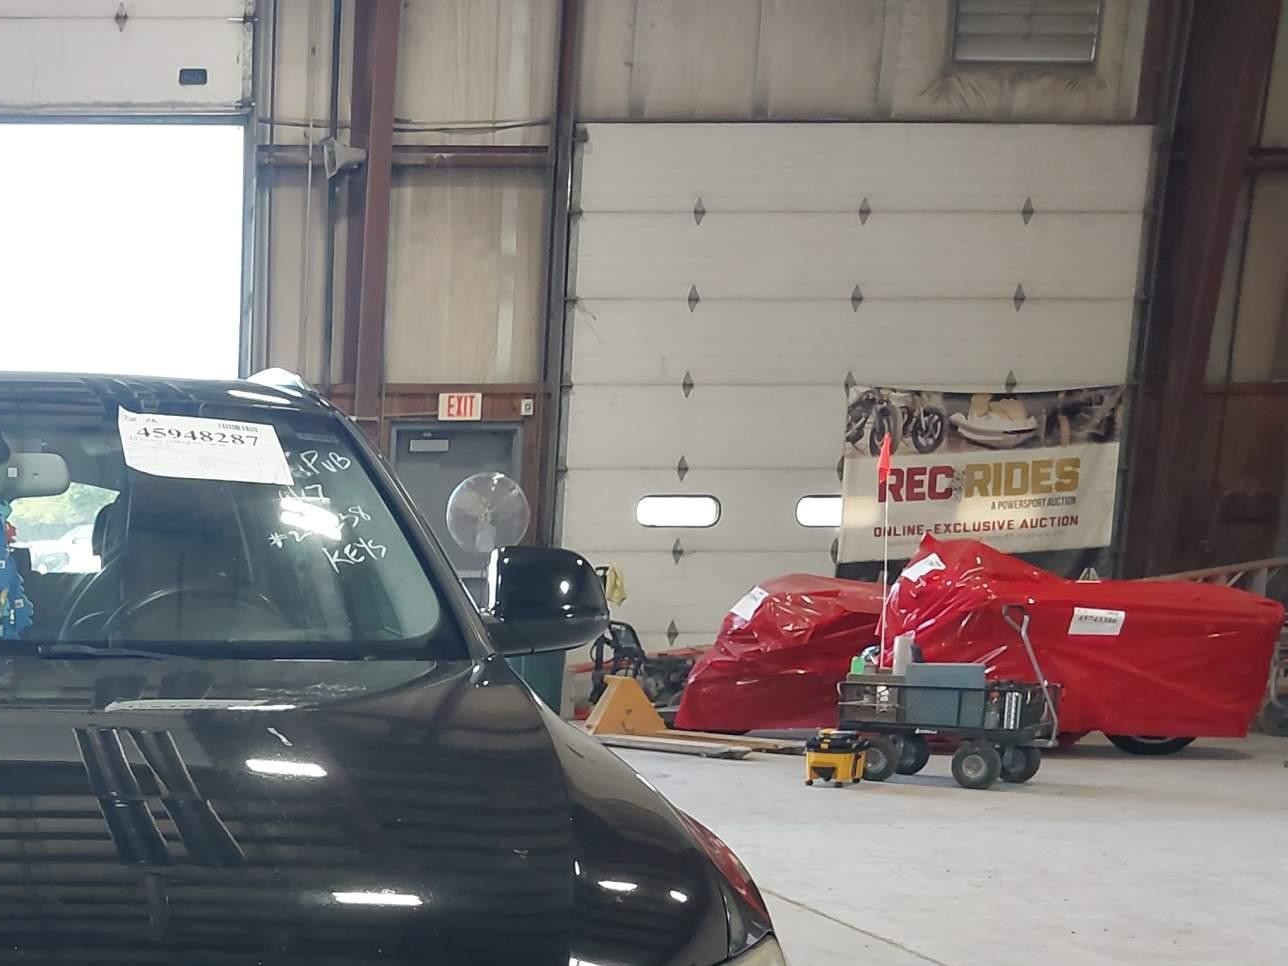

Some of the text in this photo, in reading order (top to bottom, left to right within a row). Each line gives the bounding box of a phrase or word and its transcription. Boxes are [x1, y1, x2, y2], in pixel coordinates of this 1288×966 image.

[447, 395, 476, 417] EXIT
[136, 426, 259, 447] 45948287
[877, 457, 1081, 503] REC RIDES
[991, 495, 1077, 511] A POWERSPORT AUCTION
[873, 519, 1014, 537] ONLINE-EXCLUSIVE
[1019, 515, 1079, 530] AUCTION
[322, 537, 387, 573] KEYS
